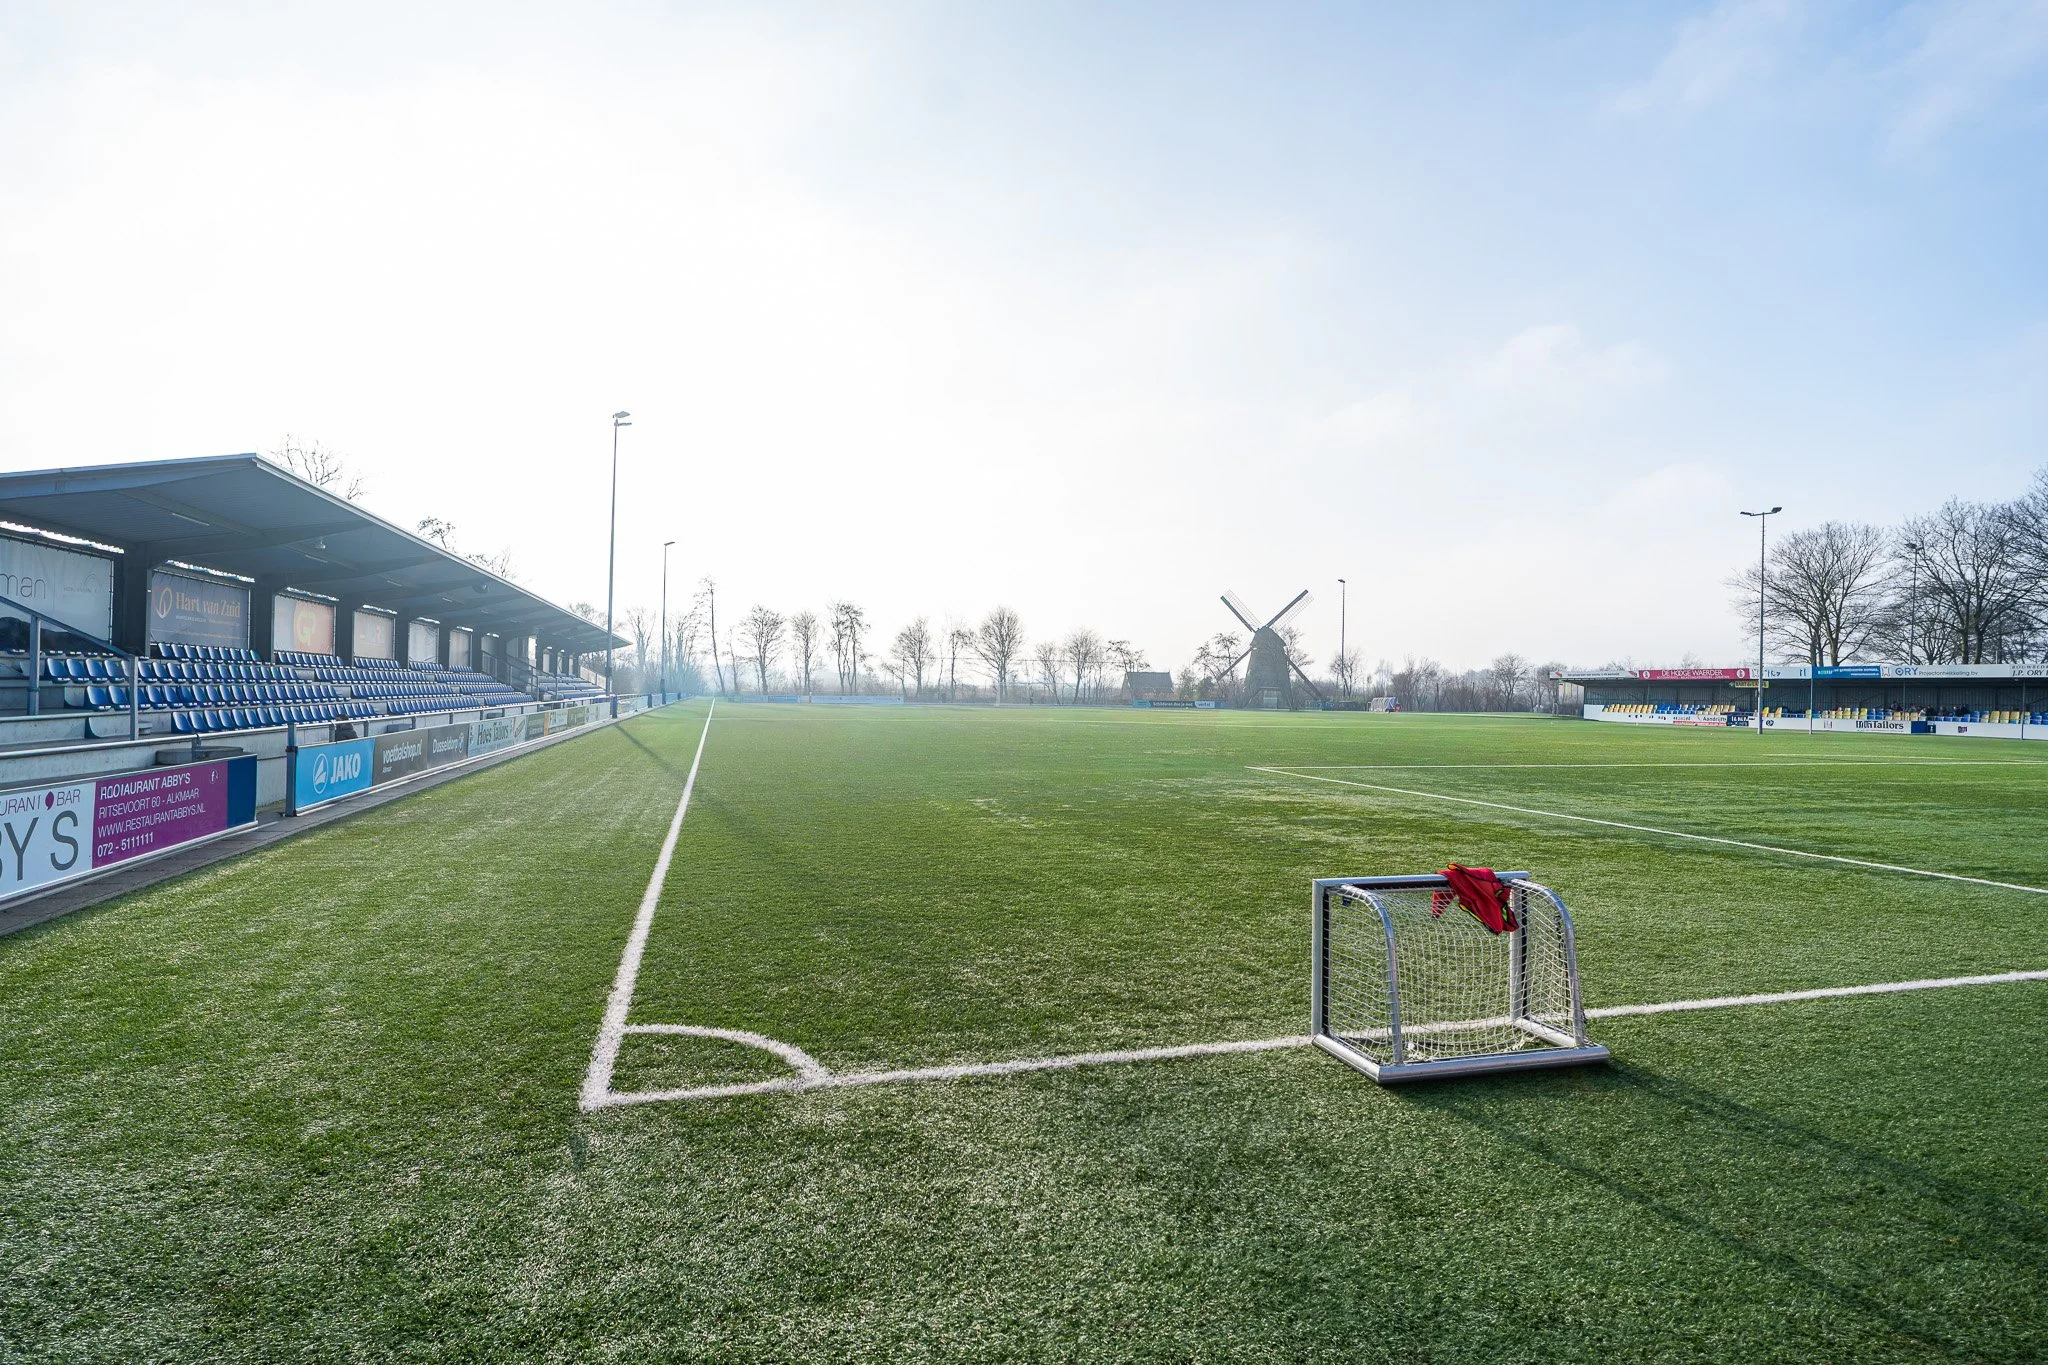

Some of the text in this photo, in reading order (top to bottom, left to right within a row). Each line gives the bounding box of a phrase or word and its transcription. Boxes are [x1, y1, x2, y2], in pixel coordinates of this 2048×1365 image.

[176, 591, 241, 618] Hart van Zuid
[161, 772, 191, 789] ABBY'S
[330, 752, 361, 784] JAKO
[56, 789, 81, 806] BAR
[98, 797, 151, 819] RITSEVOORT
[151, 795, 161, 808] 60
[166, 788, 200, 805] ALKMAAR
[97, 803, 206, 838] WWW.RESTAURANTABBYS.NL
[97, 841, 114, 858] 072
[121, 831, 154, 851] 5111111
